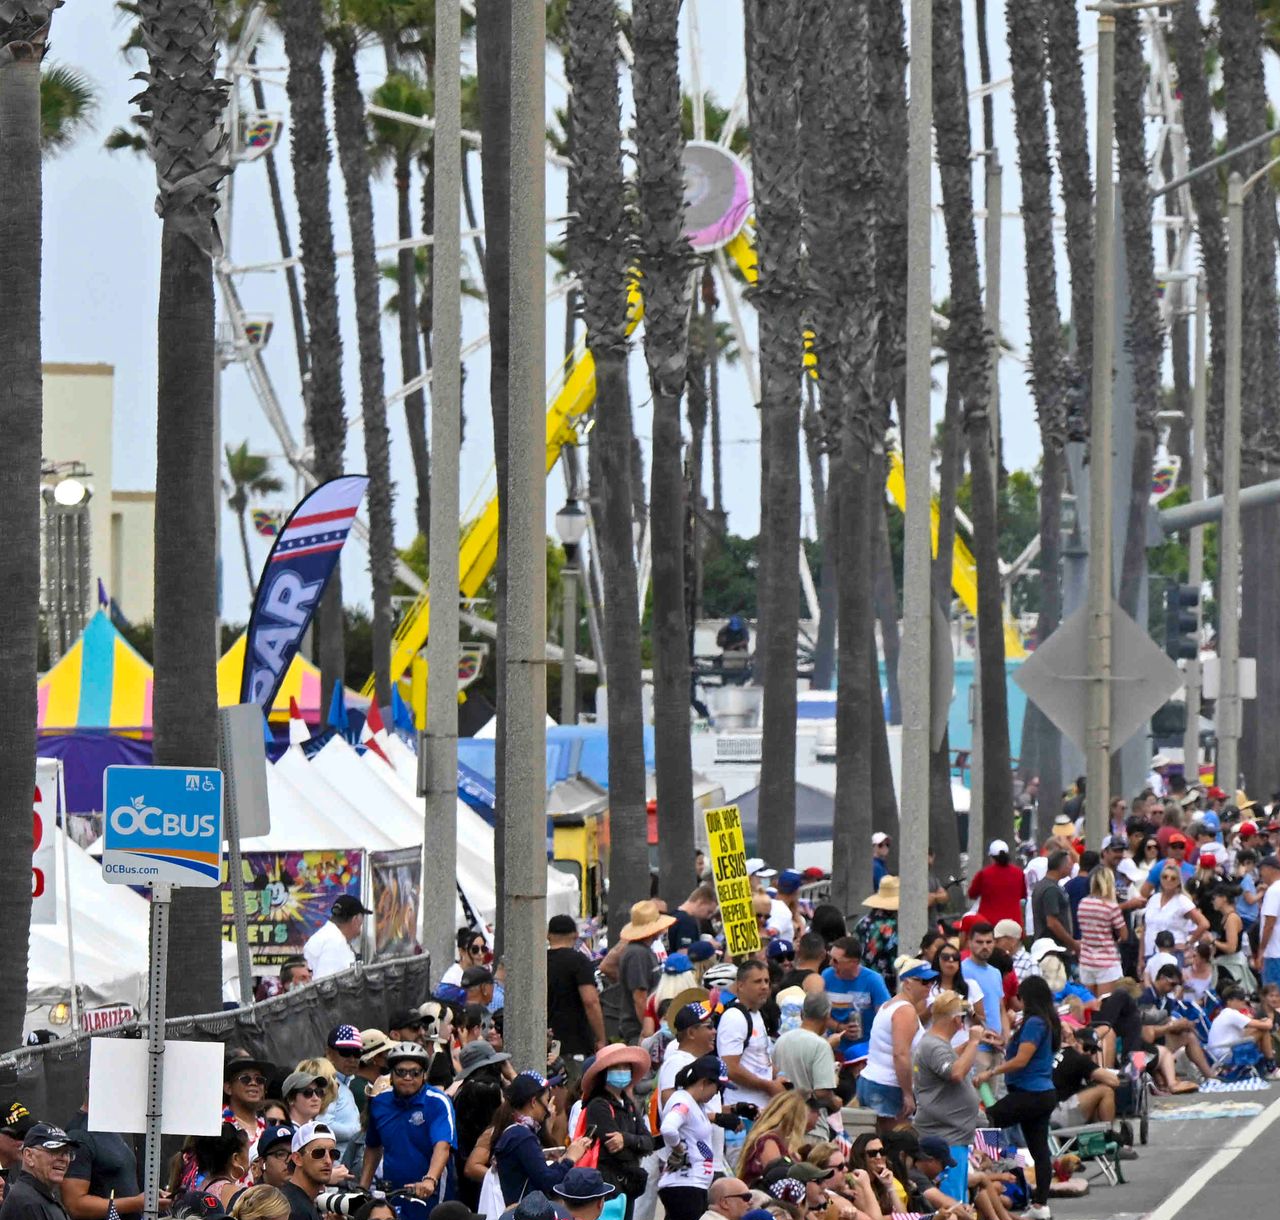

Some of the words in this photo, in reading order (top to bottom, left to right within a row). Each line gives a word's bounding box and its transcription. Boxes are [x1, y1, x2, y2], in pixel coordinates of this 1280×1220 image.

[105, 864, 159, 875] OCBus.com
[716, 852, 747, 881] JESUS
[729, 920, 758, 953] JESUS
